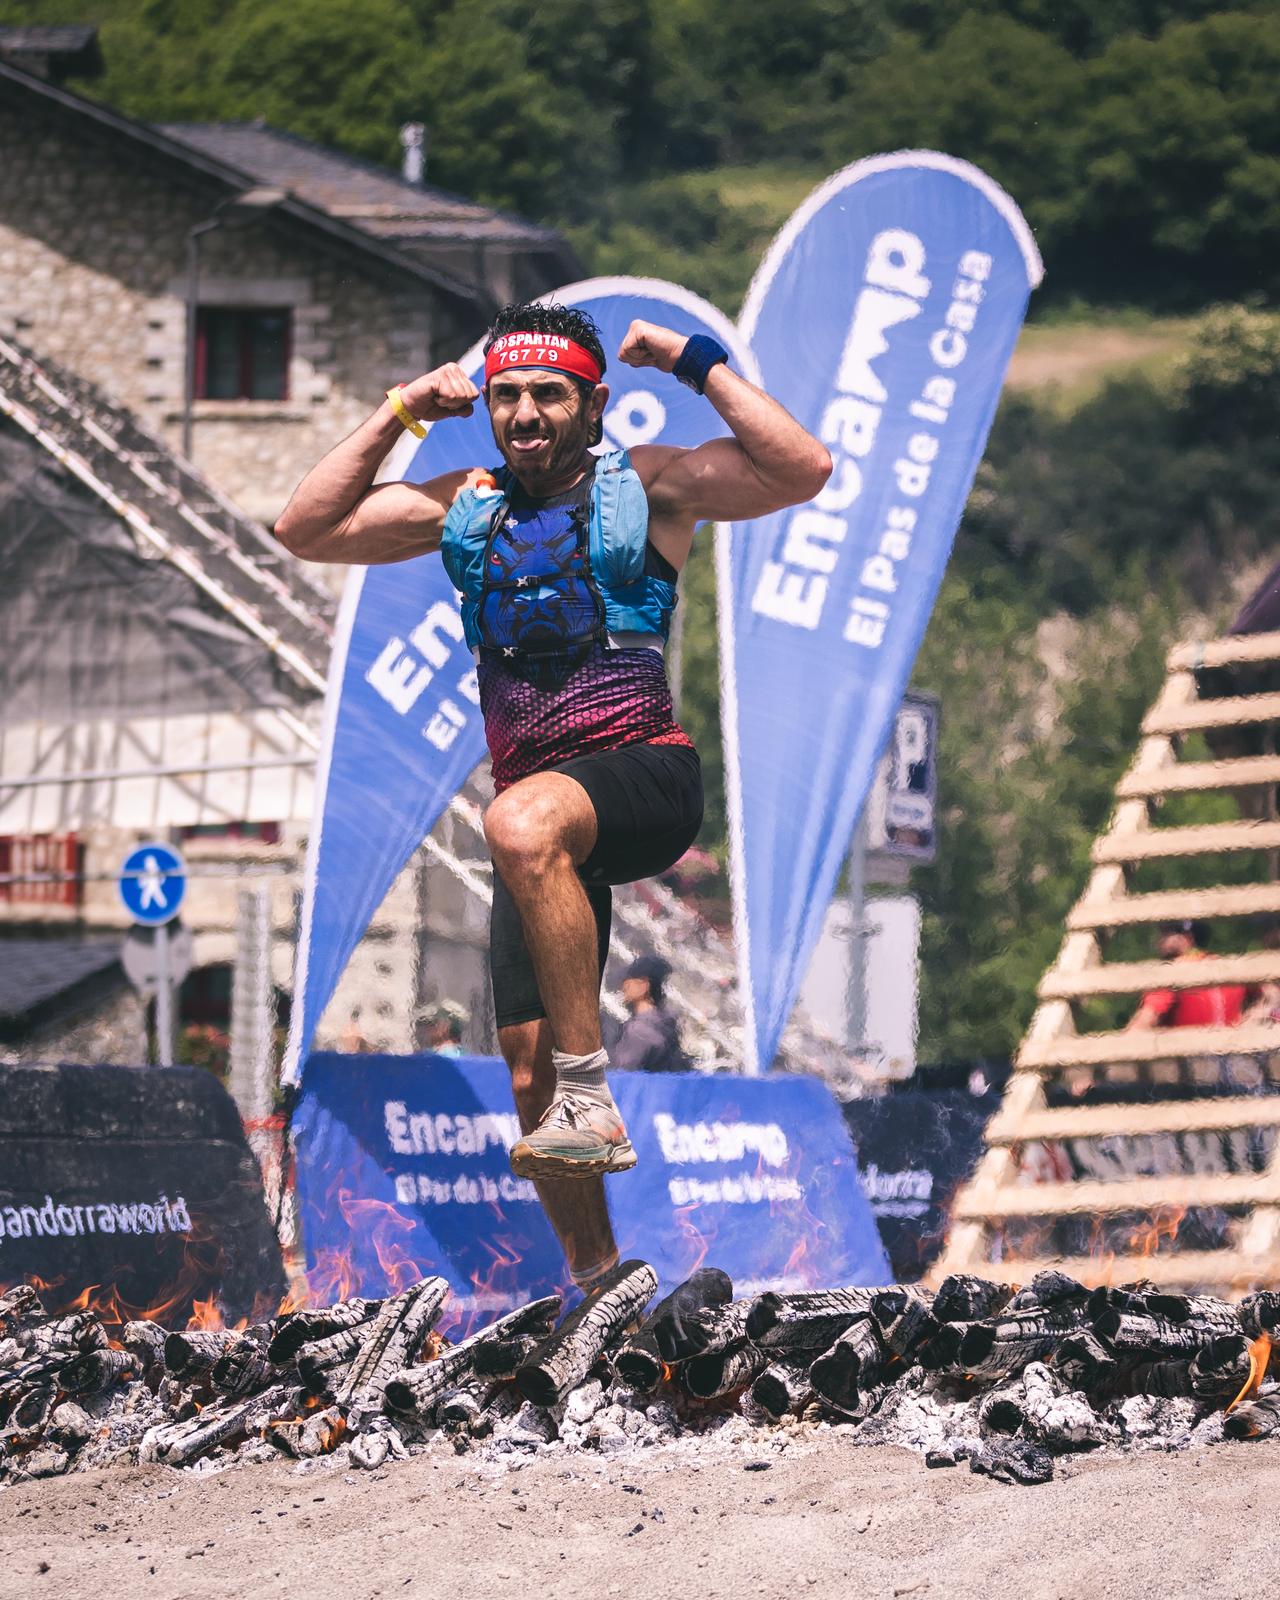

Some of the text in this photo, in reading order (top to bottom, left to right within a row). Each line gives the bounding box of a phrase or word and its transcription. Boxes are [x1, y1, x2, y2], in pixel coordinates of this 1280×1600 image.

[508, 333, 569, 350] SPARTAN
[908, 375, 957, 425] la
[752, 228, 932, 630] Encamp
[892, 432, 940, 497] de
[860, 506, 917, 593] Pas
[843, 598, 891, 649] El
[422, 700, 466, 752] El
[384, 1100, 523, 1156] Encam
